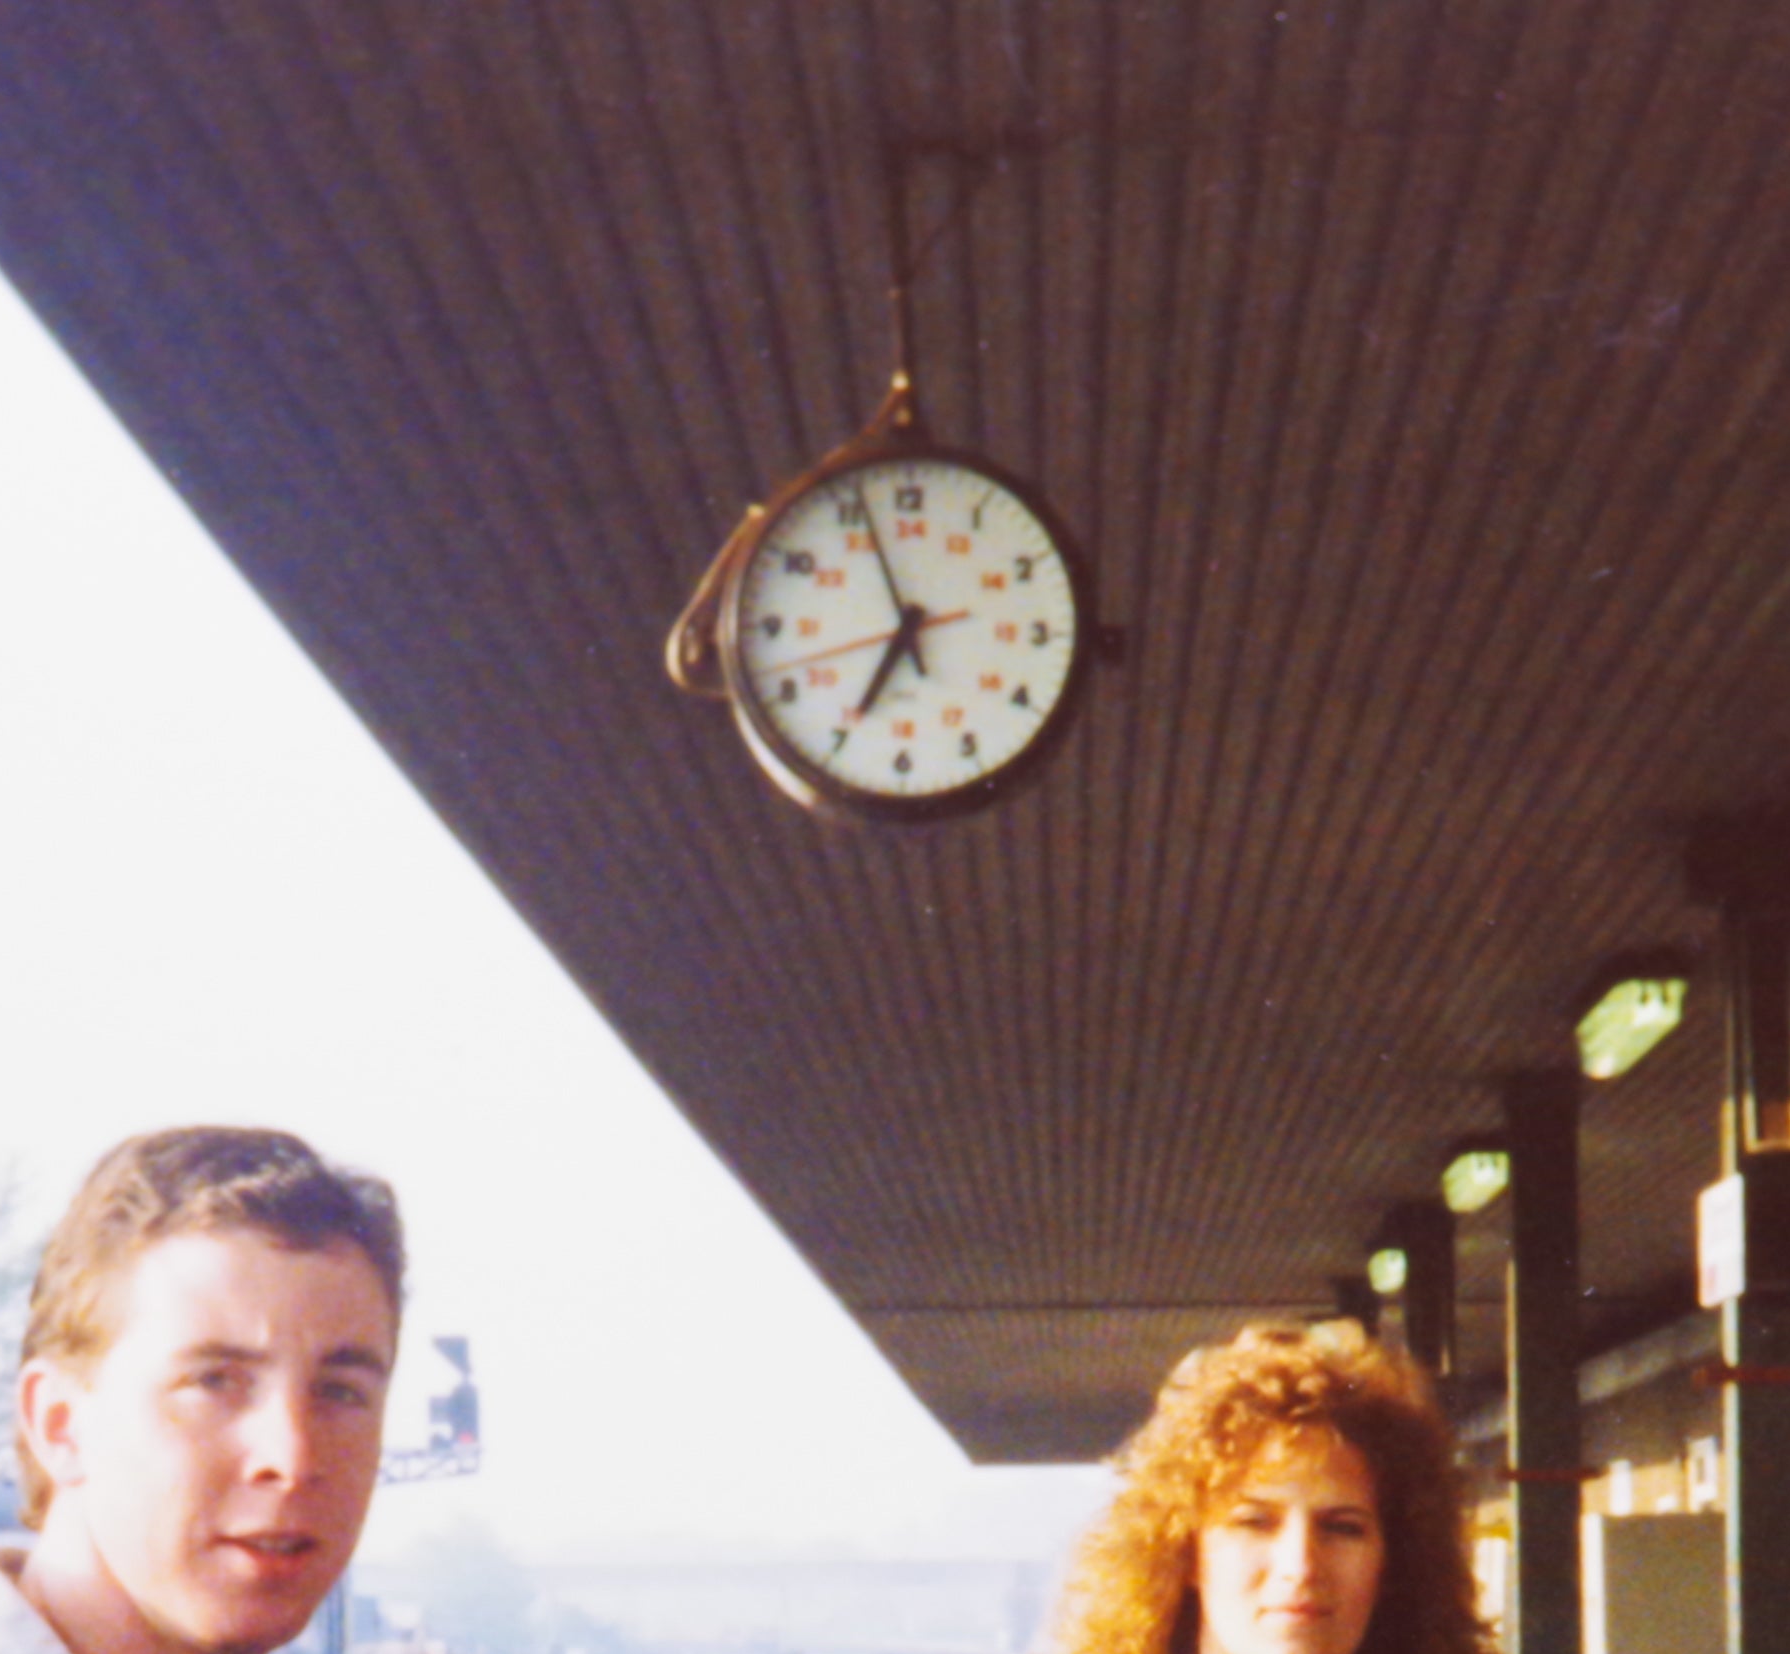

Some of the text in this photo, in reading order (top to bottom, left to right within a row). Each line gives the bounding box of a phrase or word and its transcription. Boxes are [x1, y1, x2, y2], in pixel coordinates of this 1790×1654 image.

[785, 550, 815, 574] 10
[1016, 555, 1033, 582] 2
[762, 615, 781, 637] 9
[1031, 621, 1048, 647] 3
[780, 678, 796, 703] 8
[1010, 685, 1029, 707] 4
[833, 729, 849, 752] 7
[960, 733, 976, 757] 5
[894, 747, 911, 773] 6
